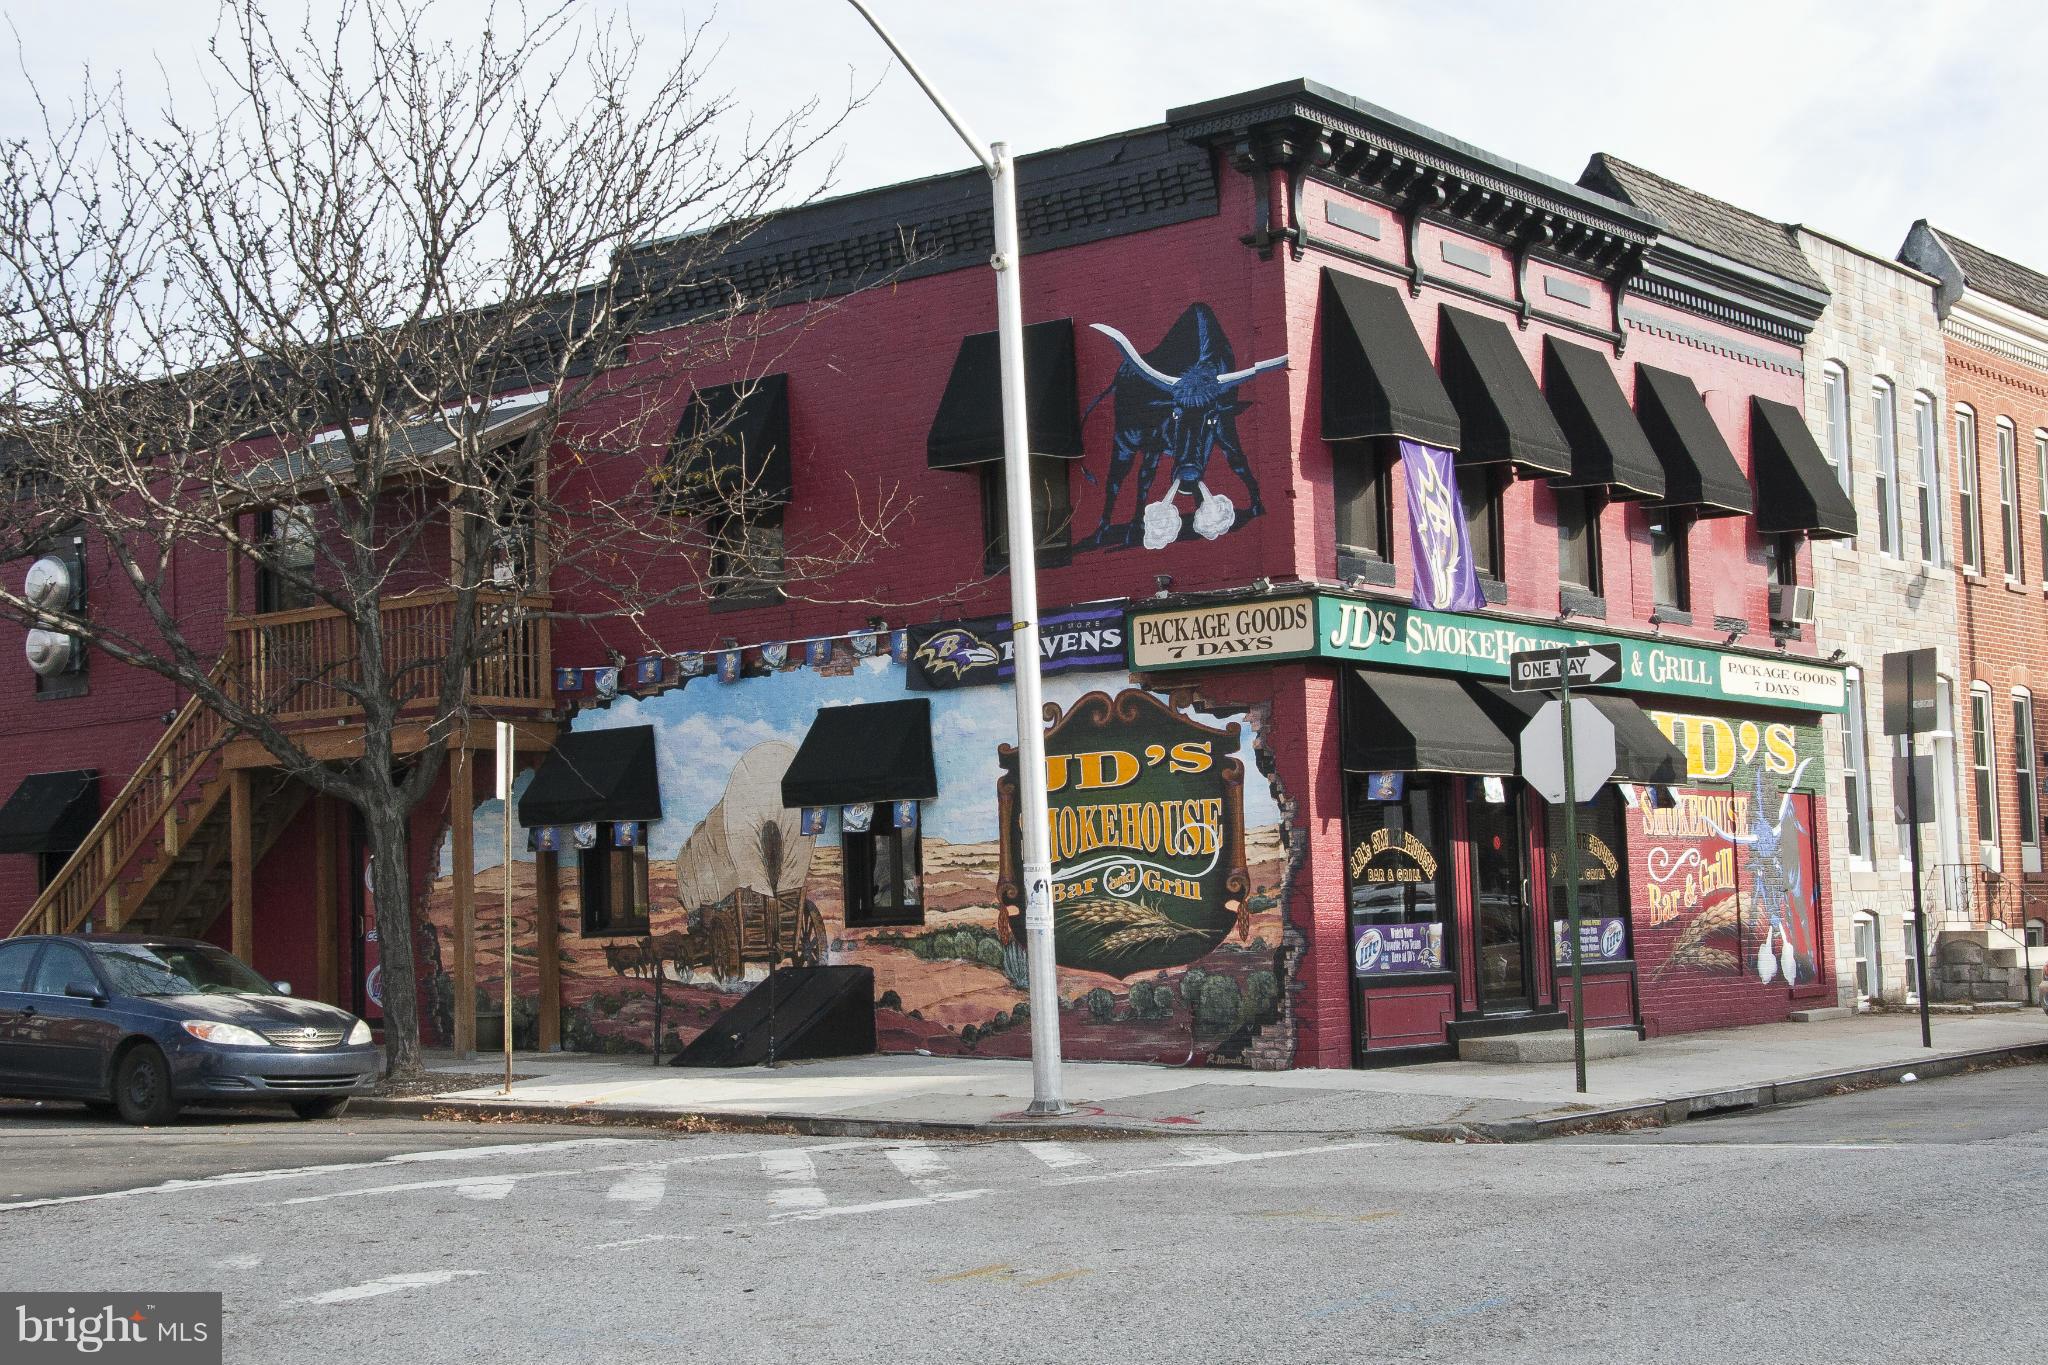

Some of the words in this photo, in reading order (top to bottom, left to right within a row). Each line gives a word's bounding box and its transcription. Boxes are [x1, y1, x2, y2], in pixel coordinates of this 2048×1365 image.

[1139, 612, 1230, 645] PACKAGE
[1236, 603, 1308, 633] GOODS
[1167, 645, 1185, 659] 7
[1196, 635, 1273, 656] DAYS
[1330, 603, 1397, 649] JD'S
[1406, 615, 1571, 665] SMOKEHO
[1631, 650, 1643, 677] &
[1649, 648, 1713, 686] GRILL
[1522, 662, 1551, 678] ONE
[1556, 658, 1587, 675] AY
[1728, 662, 1790, 680] PACKAGE
[1793, 671, 1837, 686] GOODS
[1754, 681, 1760, 691] 7
[1765, 682, 1800, 696] DAYS
[1019, 797, 1224, 863] OKEHOUSE
[1640, 789, 1749, 837] SMOKEHOUSE
[1051, 877, 1098, 903] Bar
[1108, 864, 1136, 890] and
[1143, 869, 1203, 901] Grill
[1367, 868, 1386, 882] BAR
[1387, 868, 1395, 882] &
[1396, 868, 1422, 882] GRILL
[1647, 882, 1681, 927] Bar
[1683, 873, 1698, 908] &
[1699, 847, 1737, 897] Grill
